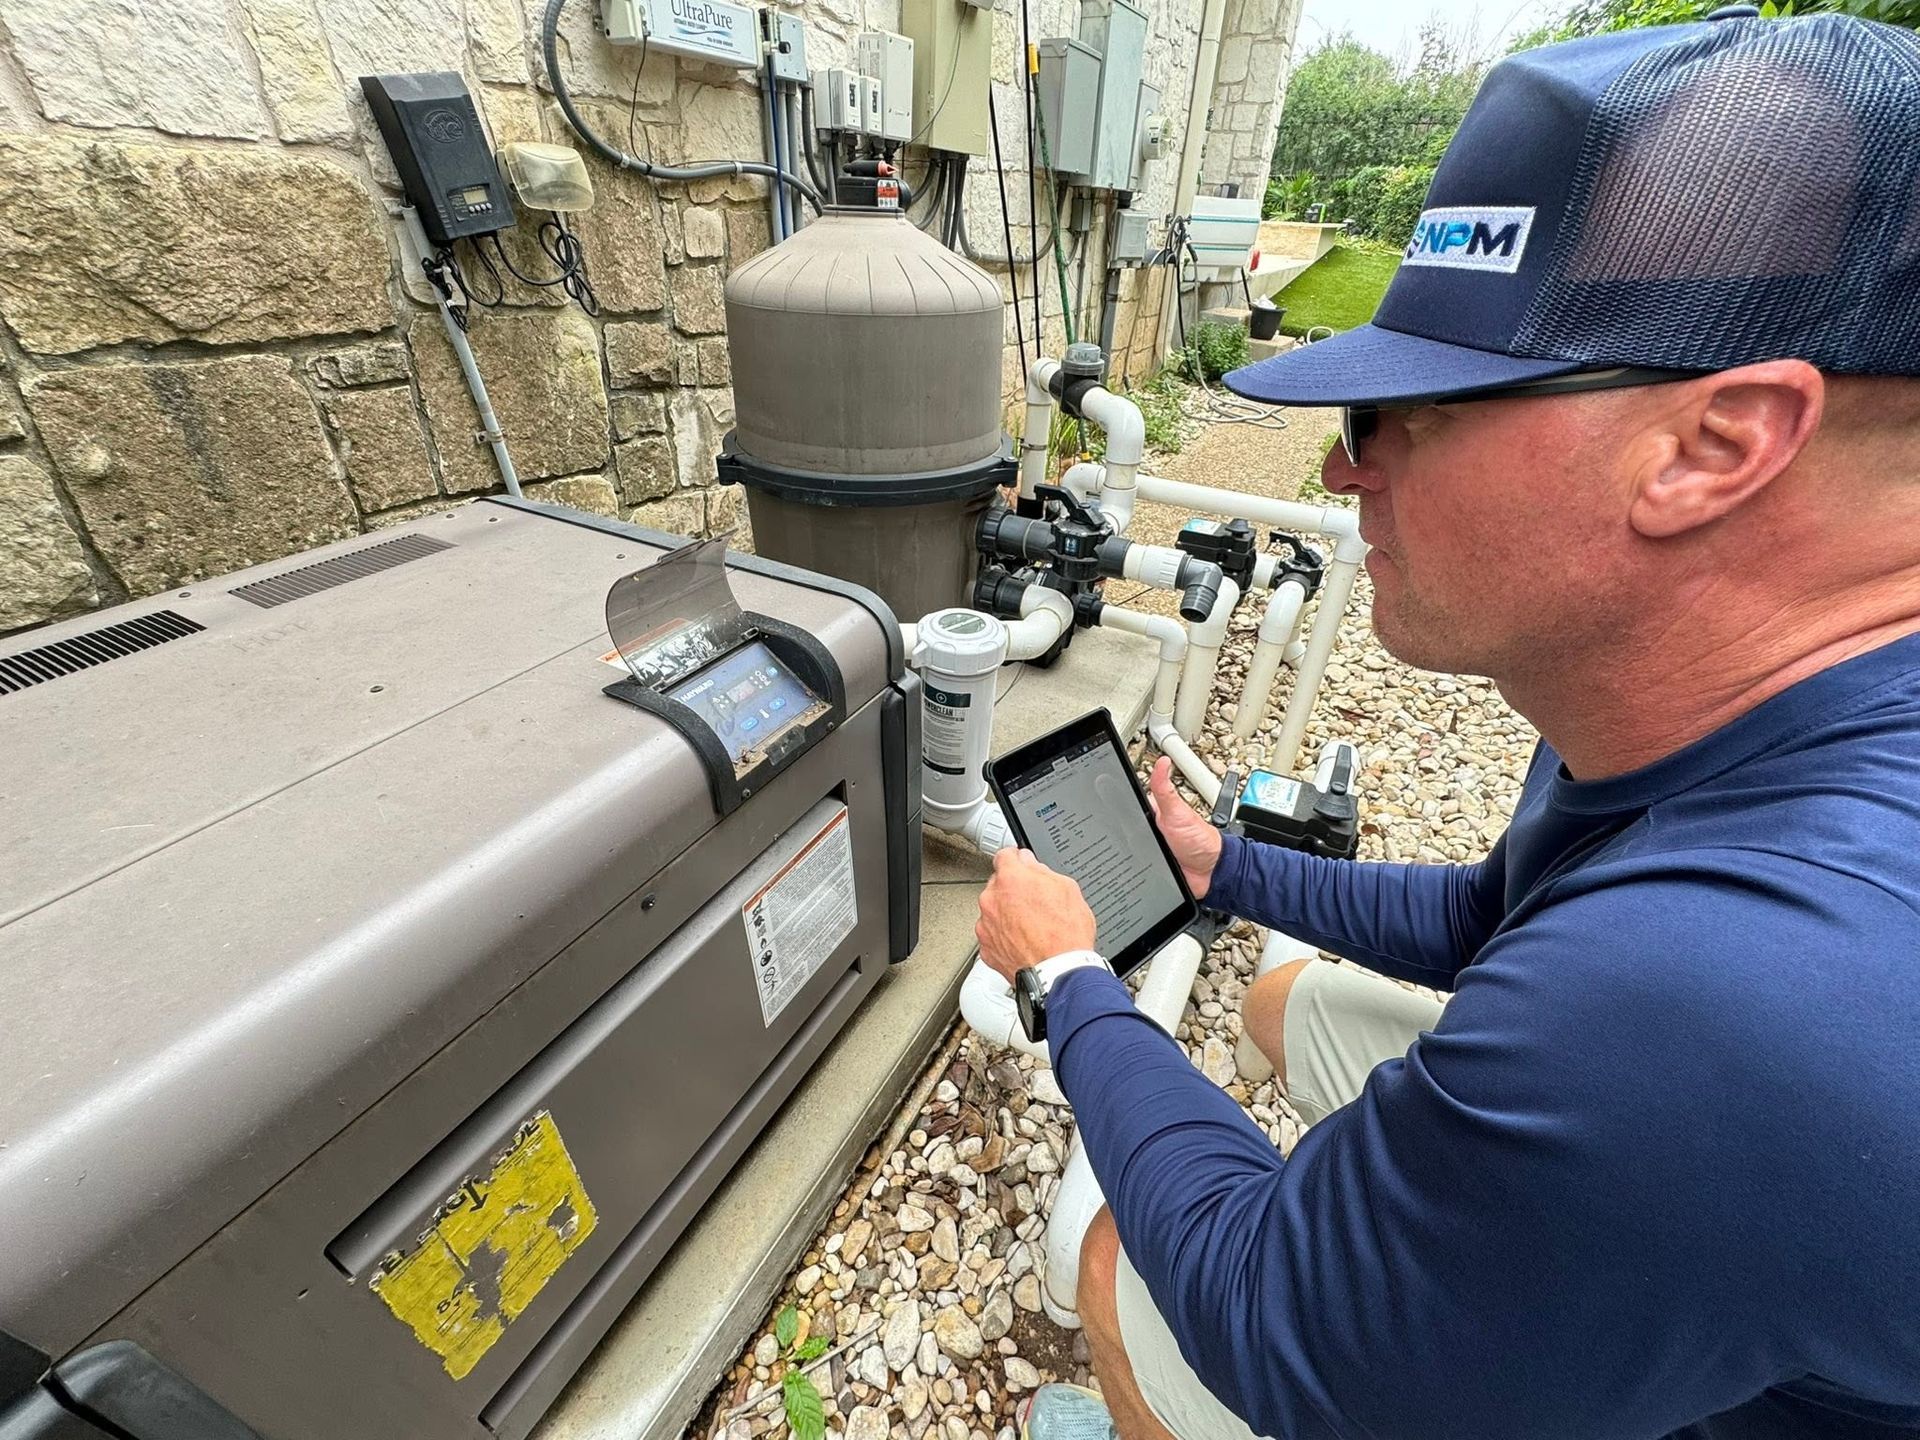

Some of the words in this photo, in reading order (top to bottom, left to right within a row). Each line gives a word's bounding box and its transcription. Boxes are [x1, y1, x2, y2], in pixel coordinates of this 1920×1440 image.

[671, 0, 733, 30] UltraPure
[1420, 220, 1520, 257] NPM
[680, 679, 715, 702] HAYWARD
